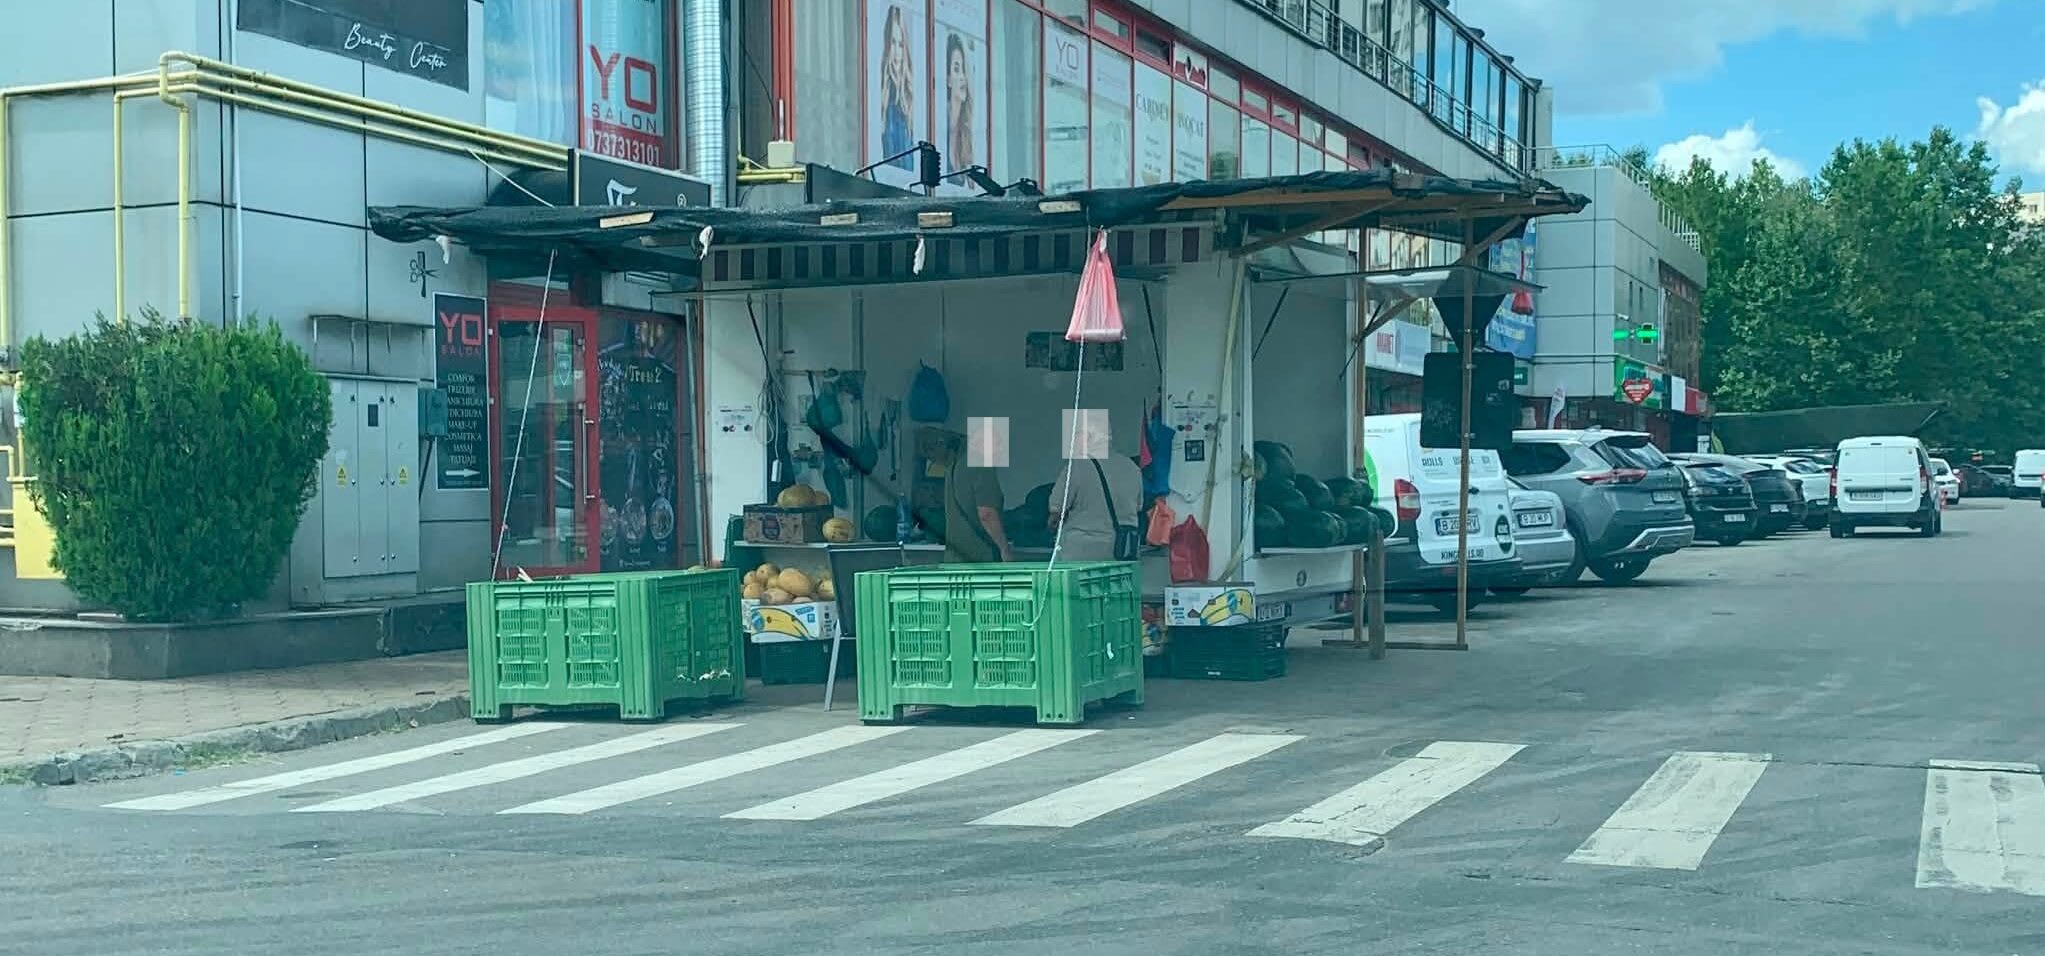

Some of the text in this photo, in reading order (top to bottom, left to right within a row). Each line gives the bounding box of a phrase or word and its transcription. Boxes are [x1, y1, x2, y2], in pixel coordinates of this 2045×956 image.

[344, 22, 450, 71] Beauty Center
[1056, 36, 1079, 70] YO
[589, 44, 658, 115] YO
[591, 103, 657, 134] SALON
[588, 128, 661, 167] 0737313101
[440, 311, 482, 346] YO
